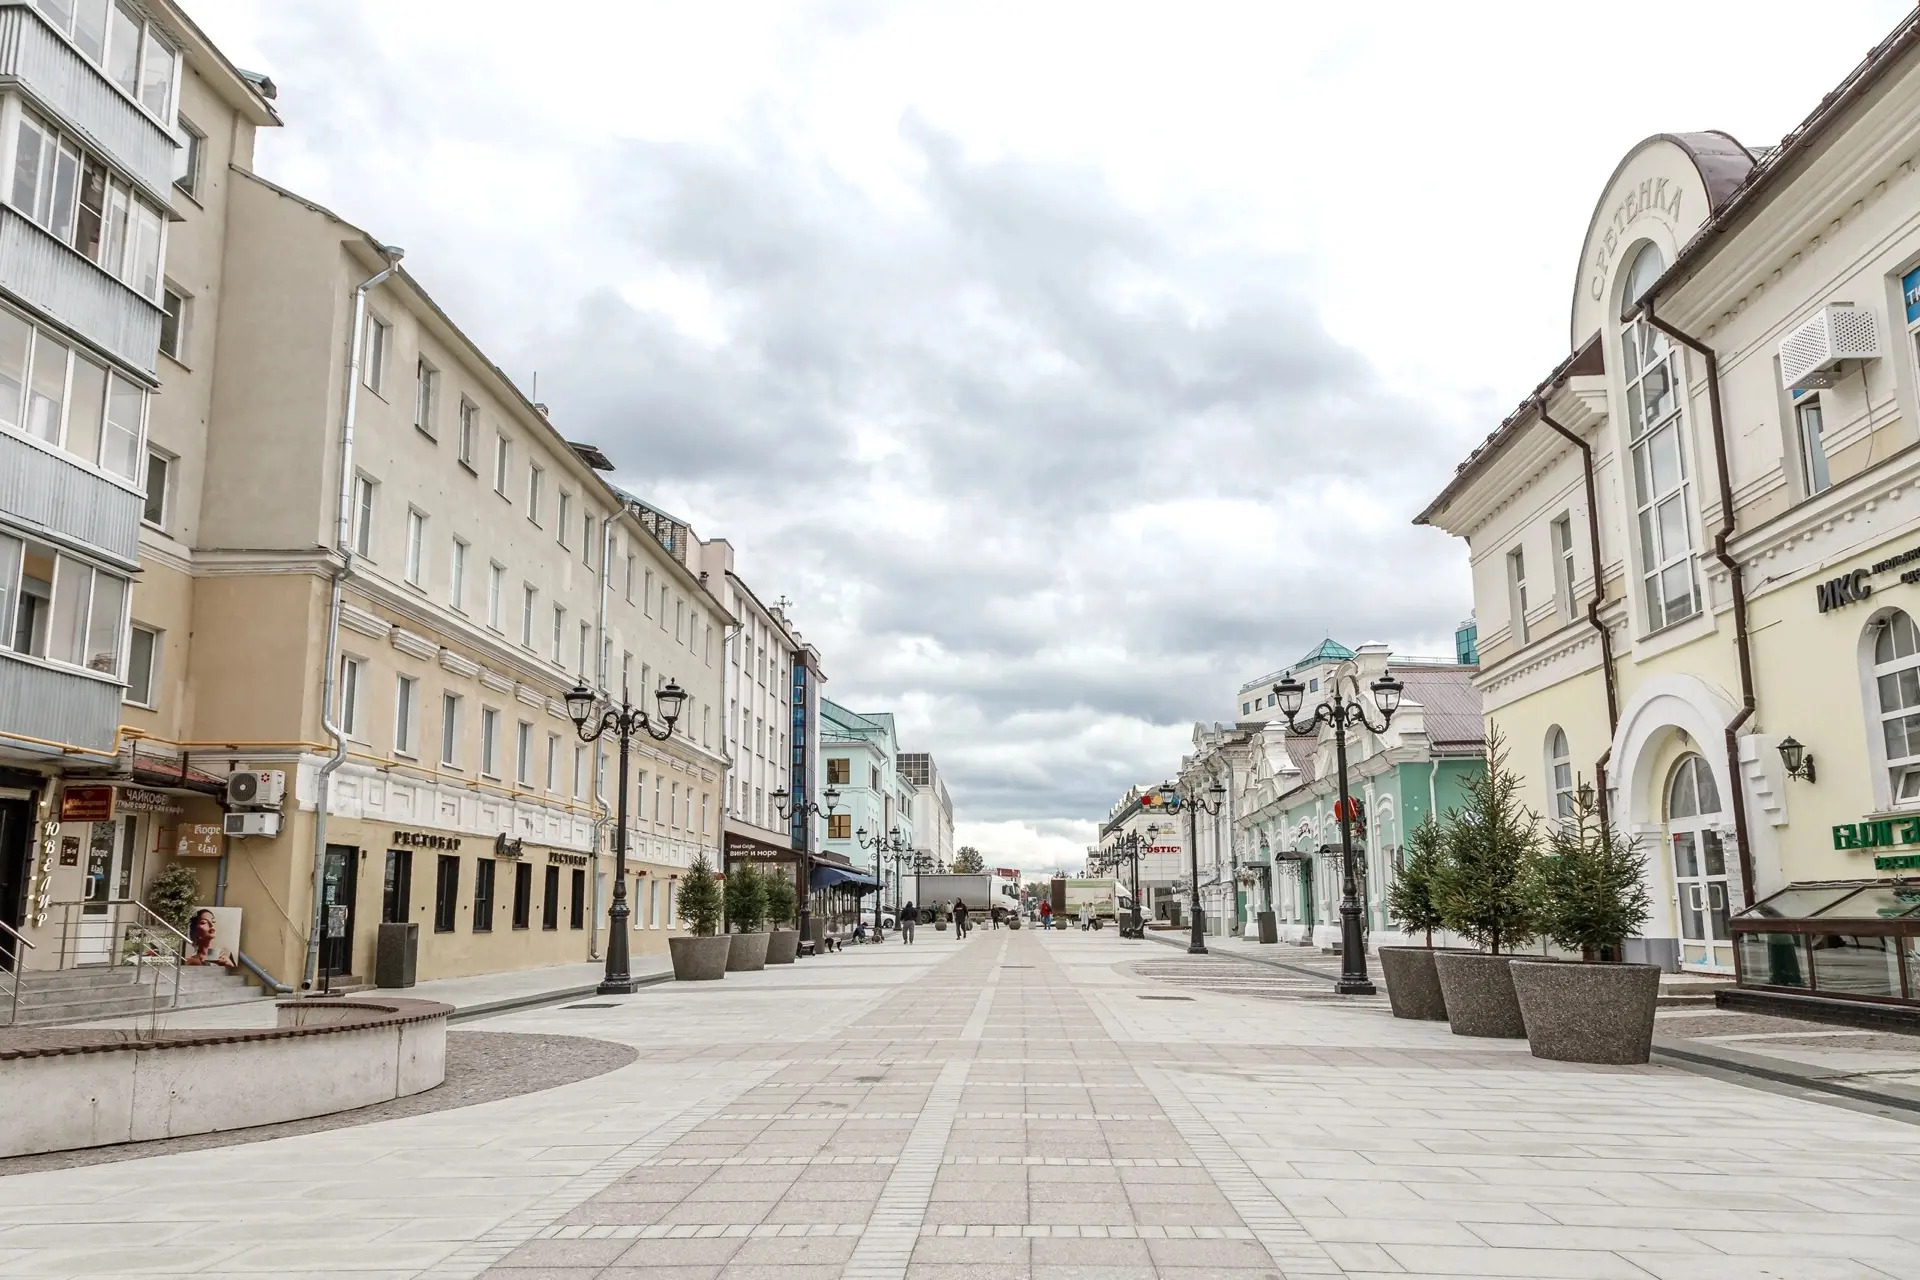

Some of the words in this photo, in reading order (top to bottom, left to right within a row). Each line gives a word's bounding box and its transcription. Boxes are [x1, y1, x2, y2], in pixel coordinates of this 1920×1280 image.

[1591, 176, 1683, 303] СРЕТЕНКА
[1816, 568, 1872, 613] ИКС
[194, 824, 221, 836] Кофе
[204, 835, 212, 843] &
[393, 830, 461, 851] РЕСТОБАР
[91, 846, 108, 858] Кофе
[197, 843, 218, 854] Чай
[757, 850, 777, 858] море
[1147, 846, 1182, 854] OSTIC'
[548, 851, 588, 867] РЕСТОБАР
[37, 821, 60, 927] ЮВЕЛИР
